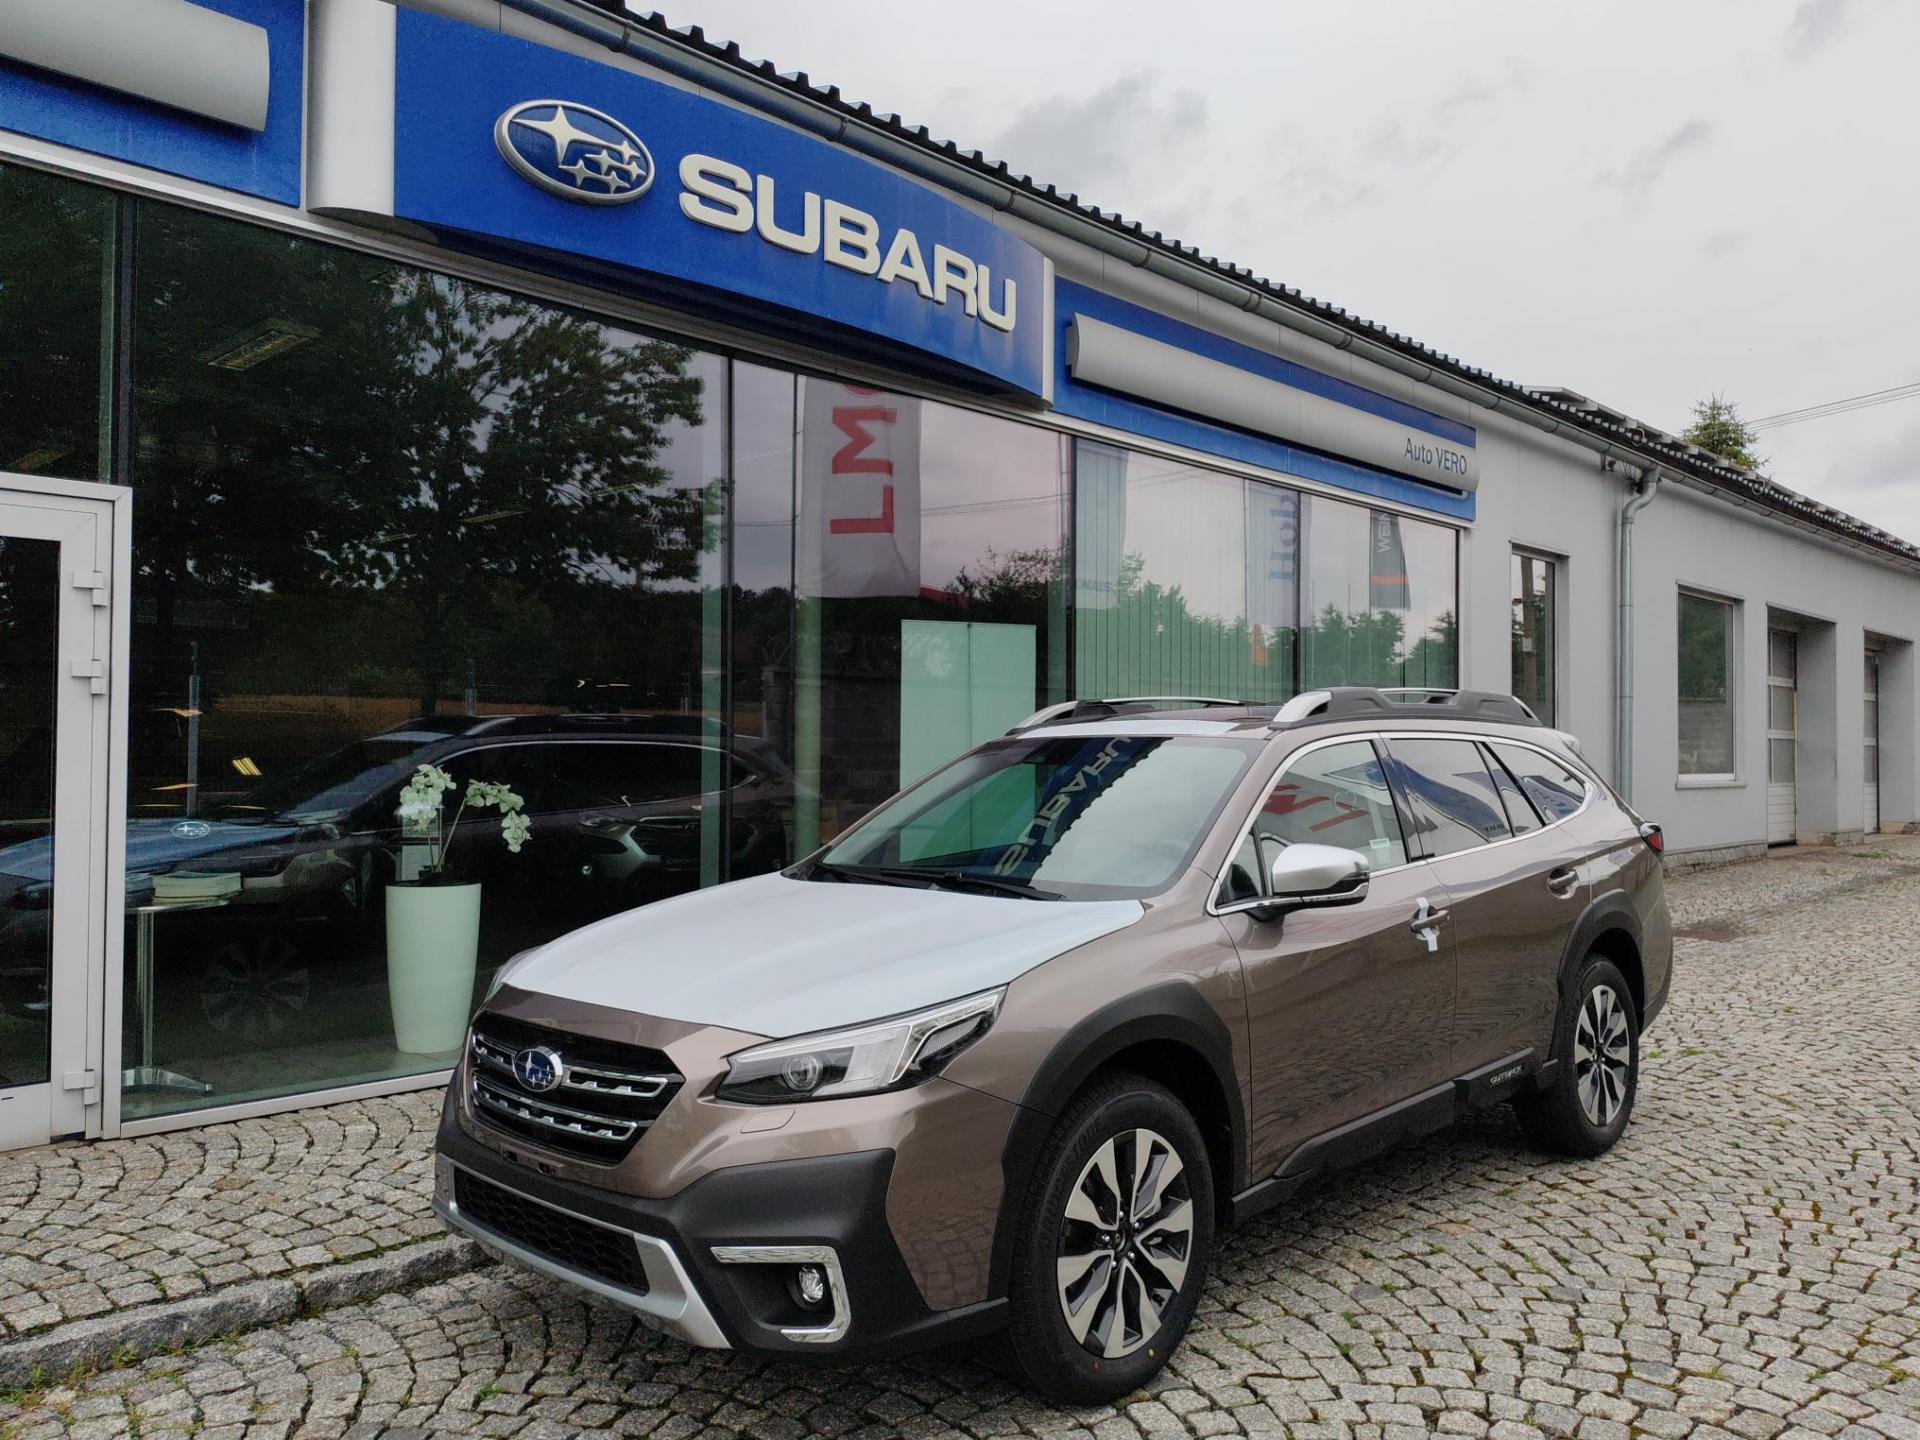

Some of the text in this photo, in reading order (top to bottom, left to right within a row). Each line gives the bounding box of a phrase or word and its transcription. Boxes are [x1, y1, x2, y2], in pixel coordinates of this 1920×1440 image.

[679, 153, 1016, 332] SUBARU
[830, 384, 897, 534] LM
[1405, 438, 1467, 475] Auto VERO
